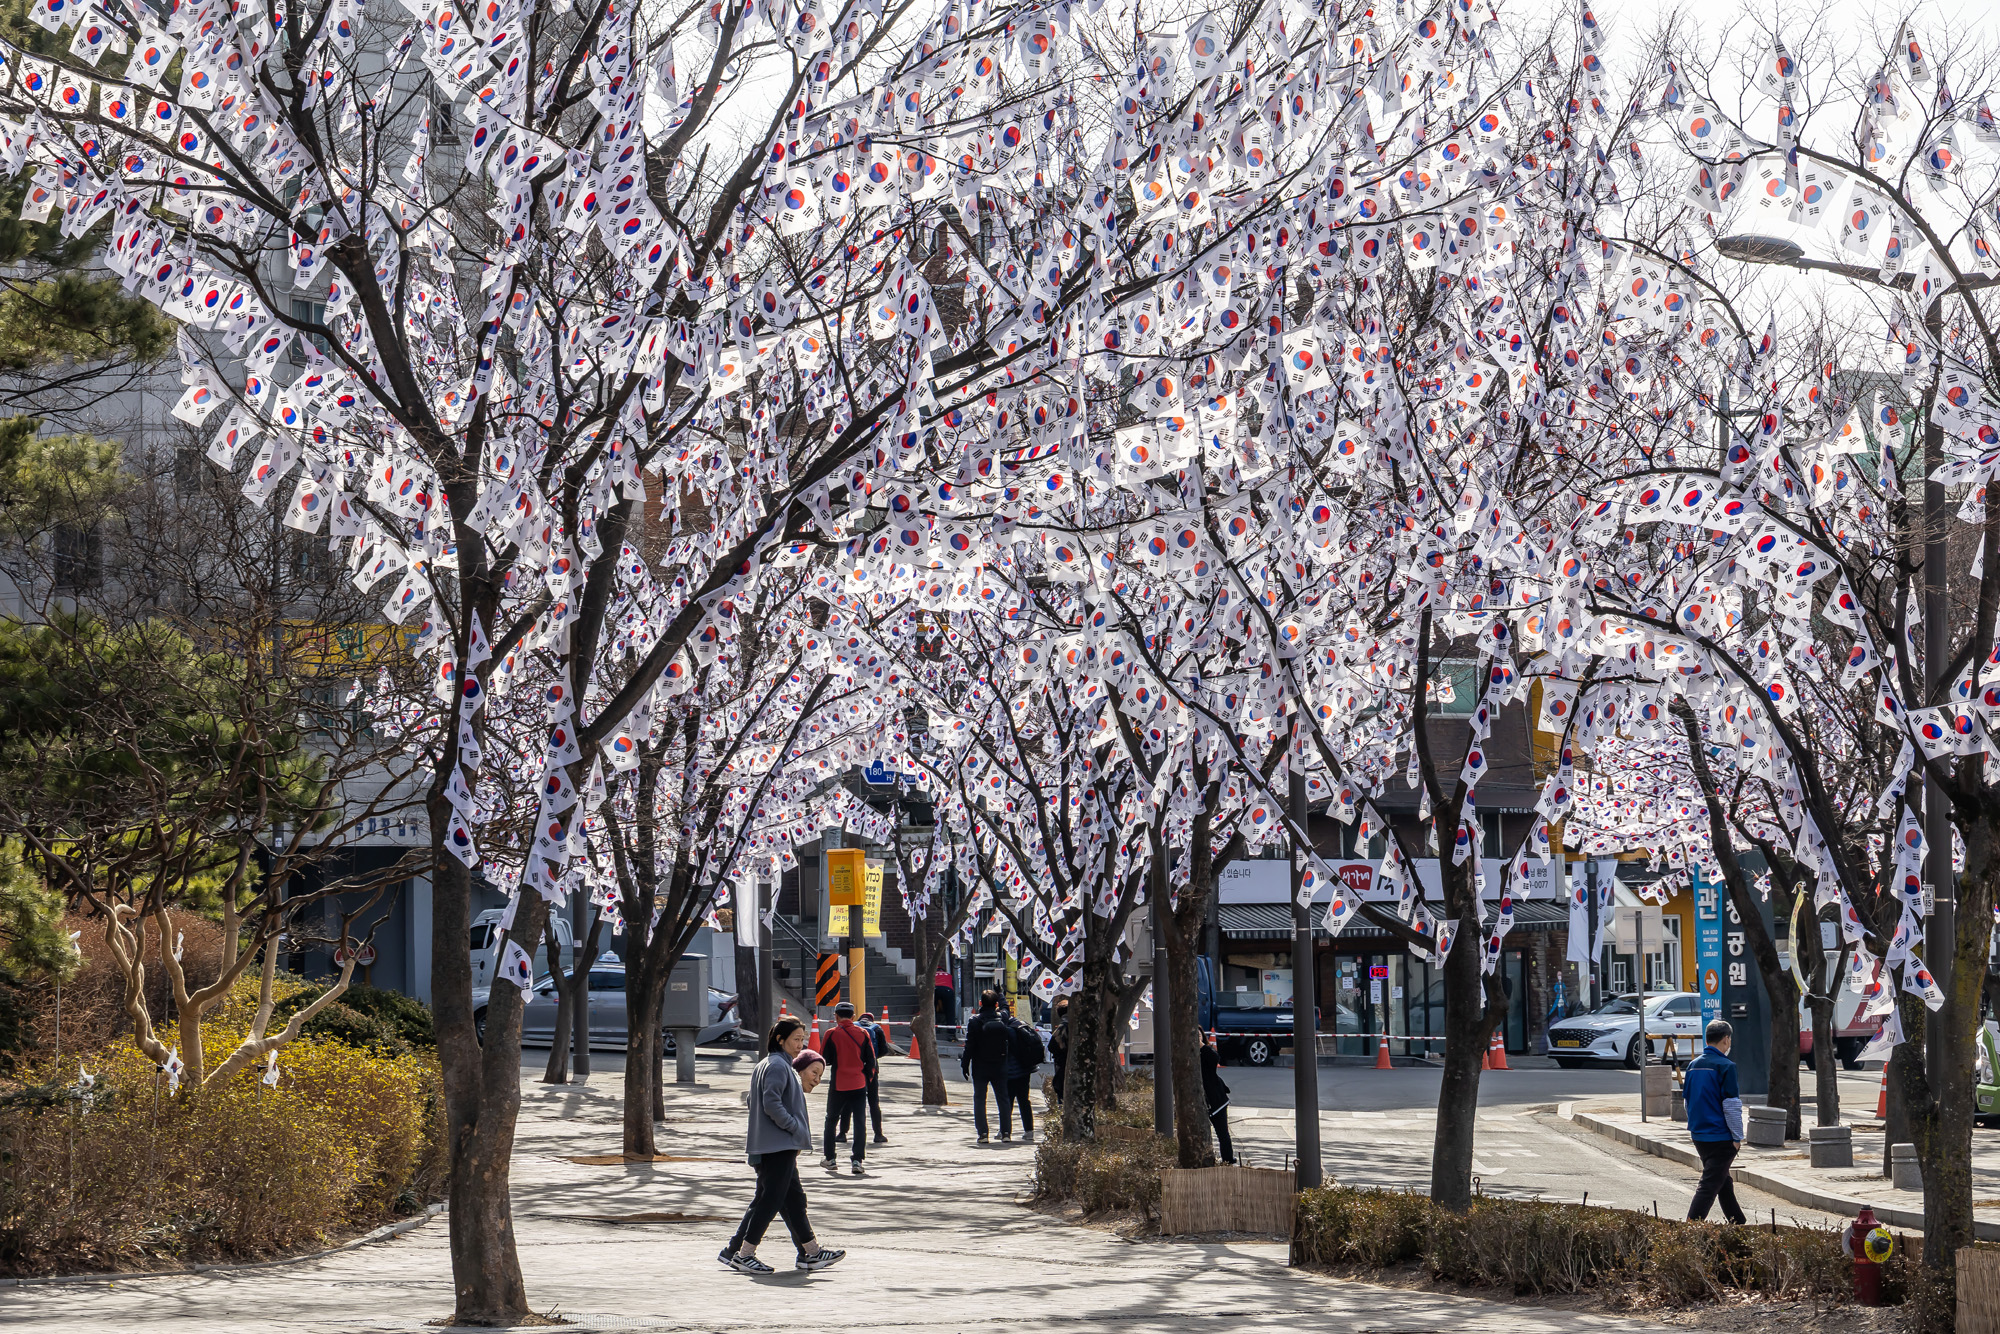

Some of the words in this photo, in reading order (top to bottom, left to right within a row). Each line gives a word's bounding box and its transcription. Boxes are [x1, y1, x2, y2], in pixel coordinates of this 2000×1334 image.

[868, 768, 882, 776] 180
[1226, 868, 1251, 879] 있습니다
[1371, 967, 1388, 978] OPEN
[1703, 998, 1720, 1009] 150M
